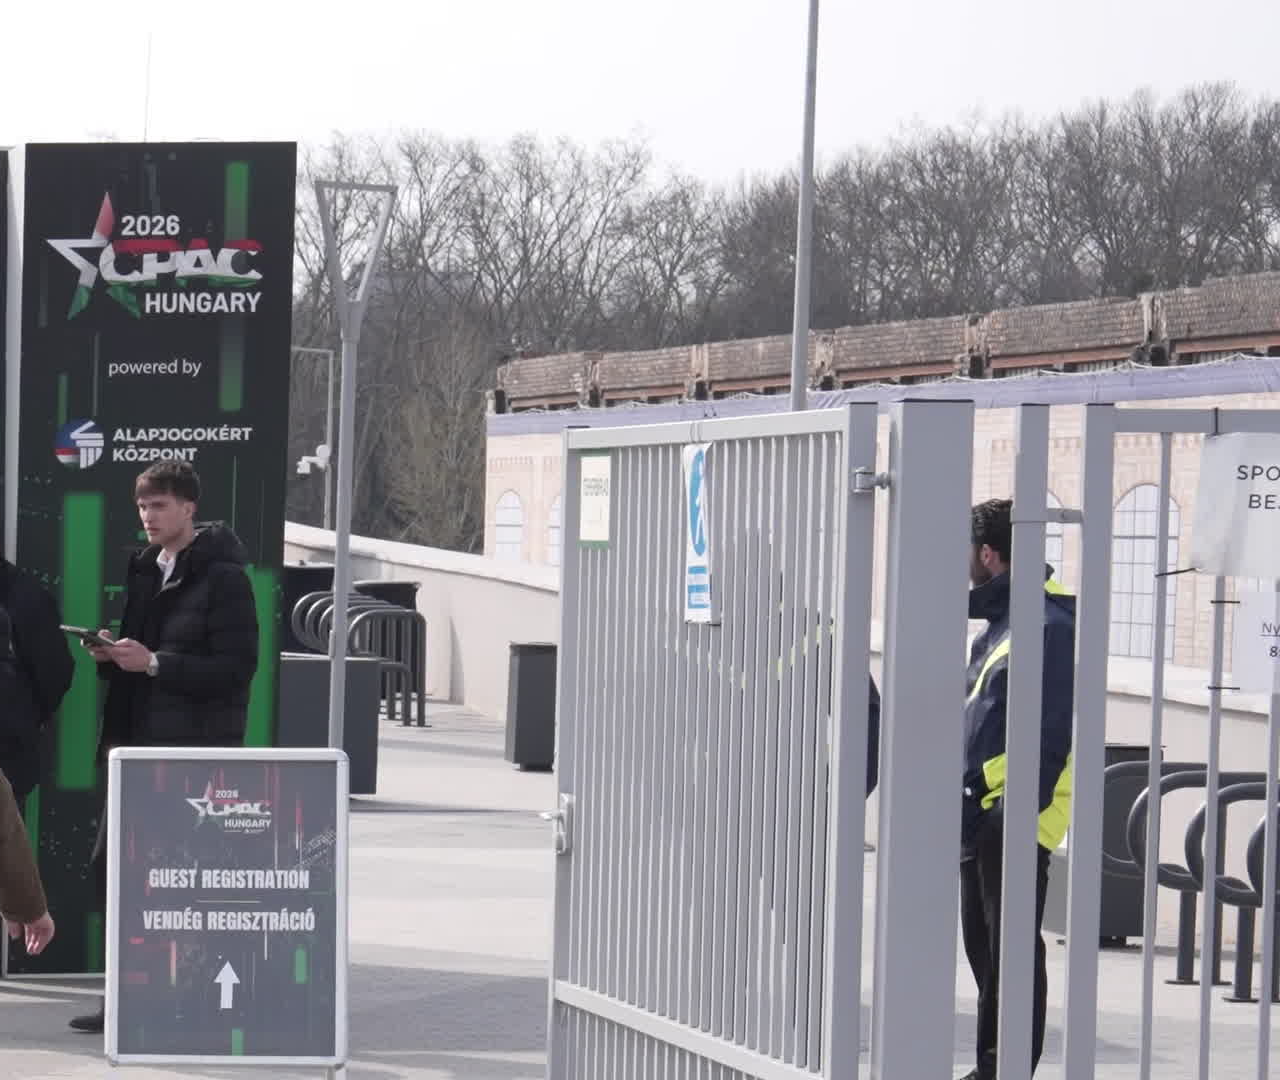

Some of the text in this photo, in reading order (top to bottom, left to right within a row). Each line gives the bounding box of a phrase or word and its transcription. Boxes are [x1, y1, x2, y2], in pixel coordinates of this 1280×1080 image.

[121, 215, 180, 236] 2026
[98, 238, 264, 288] CPAC
[144, 292, 262, 313] HUNGARY
[108, 360, 202, 377] powered by
[112, 424, 253, 441] ALAPJOGOKÉRT
[112, 444, 198, 462] KÖZPONT
[1248, 494, 1280, 510] BE
[224, 818, 272, 829] HUNGARY
[148, 868, 310, 889] GUEST REGISTRATION
[142, 907, 316, 931] VENDÉG REGISZTRÁCIÓ
